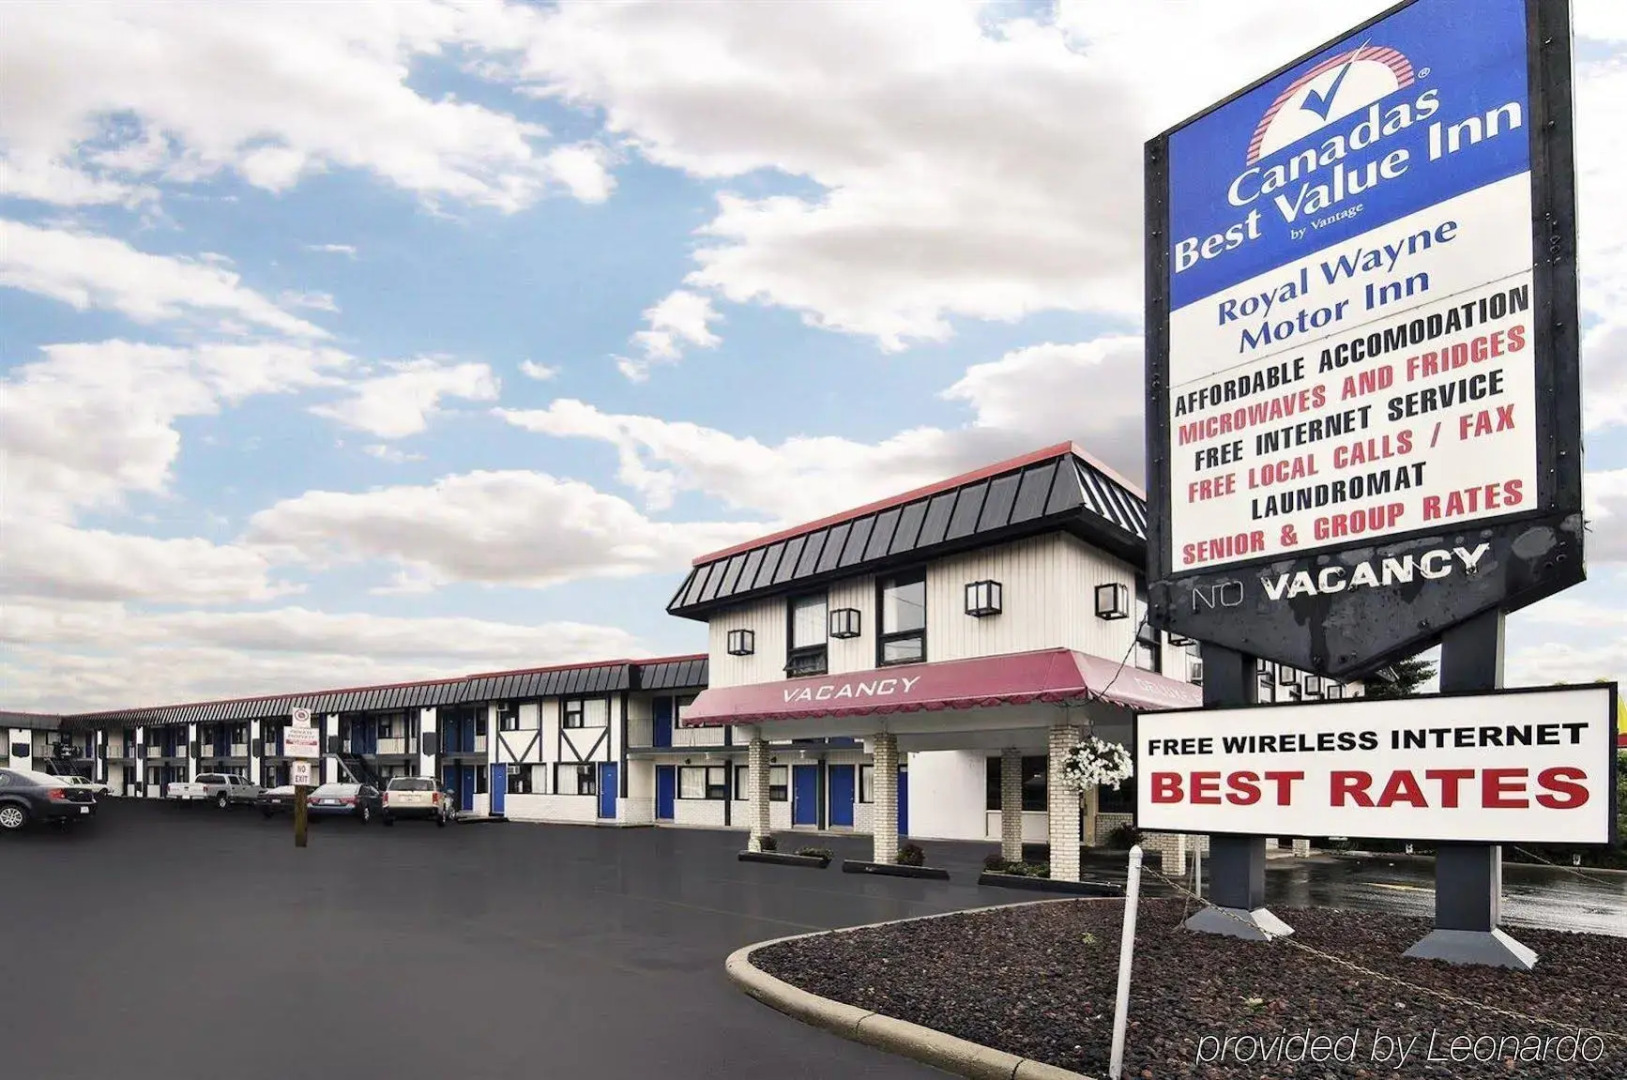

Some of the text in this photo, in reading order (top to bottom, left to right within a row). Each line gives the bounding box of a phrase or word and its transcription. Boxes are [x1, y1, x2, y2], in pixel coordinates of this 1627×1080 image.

[1175, 102, 1523, 273] Best Value Inn
[1228, 89, 1440, 207] Canadas
[1290, 203, 1363, 241] by Vantage
[1218, 220, 1457, 326] Royal Wayne
[1239, 269, 1430, 354] Motor Inn
[1175, 285, 1528, 418] AFFORDABLE ACCOMODATION
[1178, 325, 1527, 446] MICROWAVES AND FRIDGES
[1188, 474, 1236, 504] FREE
[1249, 454, 1319, 489] LOCAL
[1333, 429, 1413, 470] CALLS
[1459, 403, 1516, 441] FAX
[1195, 368, 1504, 472] FREE INTERNET SERVICE
[1183, 481, 1523, 565] SENIOR & GROUP RATES
[1251, 461, 1427, 521] LAUNDROMAT
[1191, 543, 1489, 611] NO VACANCY
[784, 677, 920, 702] VACANCY
[295, 775, 308, 783] EXIT
[297, 765, 306, 773] NO
[1148, 722, 1589, 756] FREE WIRELESS INTERNET
[1150, 767, 1590, 810] BEST RATES
